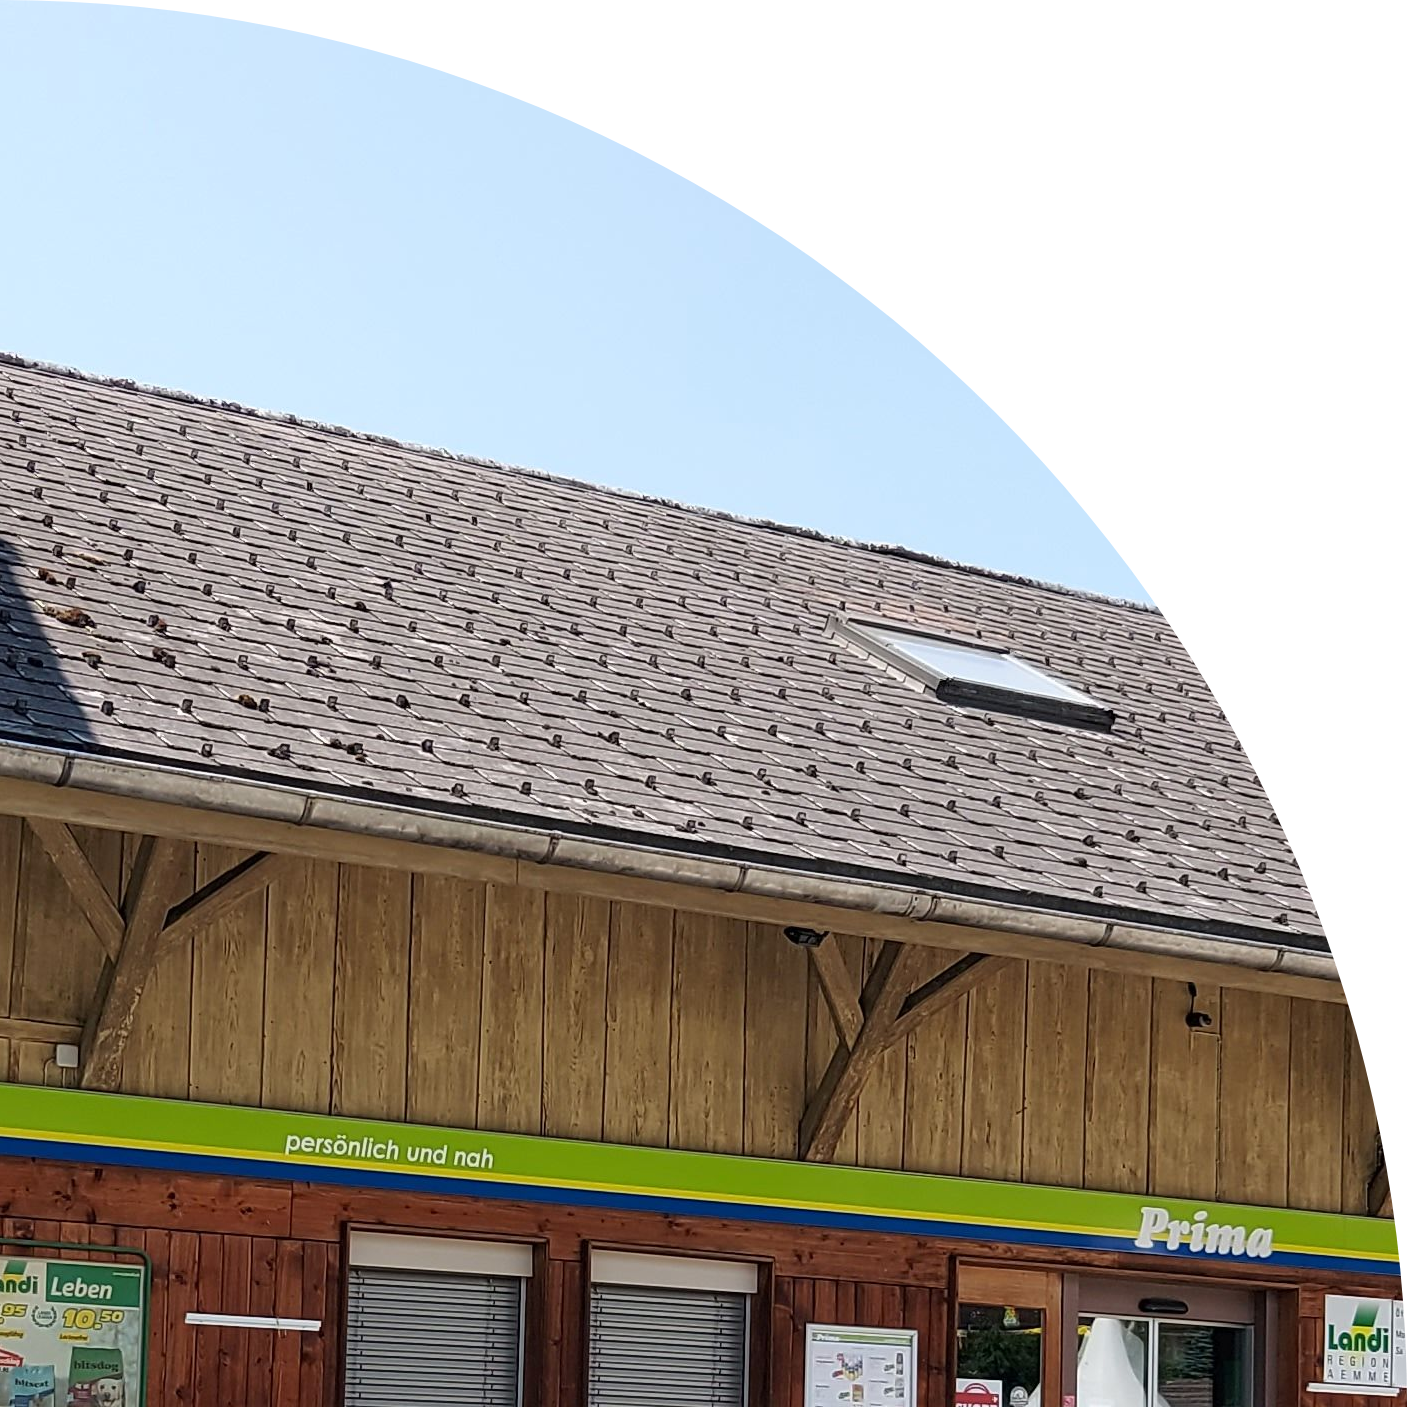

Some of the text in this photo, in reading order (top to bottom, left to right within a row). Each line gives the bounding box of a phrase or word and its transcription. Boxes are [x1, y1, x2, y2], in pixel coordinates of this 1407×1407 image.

[284, 1134, 494, 1169] persönlich und nah
[1134, 1207, 1273, 1259] Prima
[50, 1276, 113, 1300] Leben
[63, 1308, 125, 1331] 10.50
[1328, 1324, 1389, 1354] Landi
[1327, 1354, 1389, 1369] REGION
[1327, 1368, 1389, 1383] AEMME
